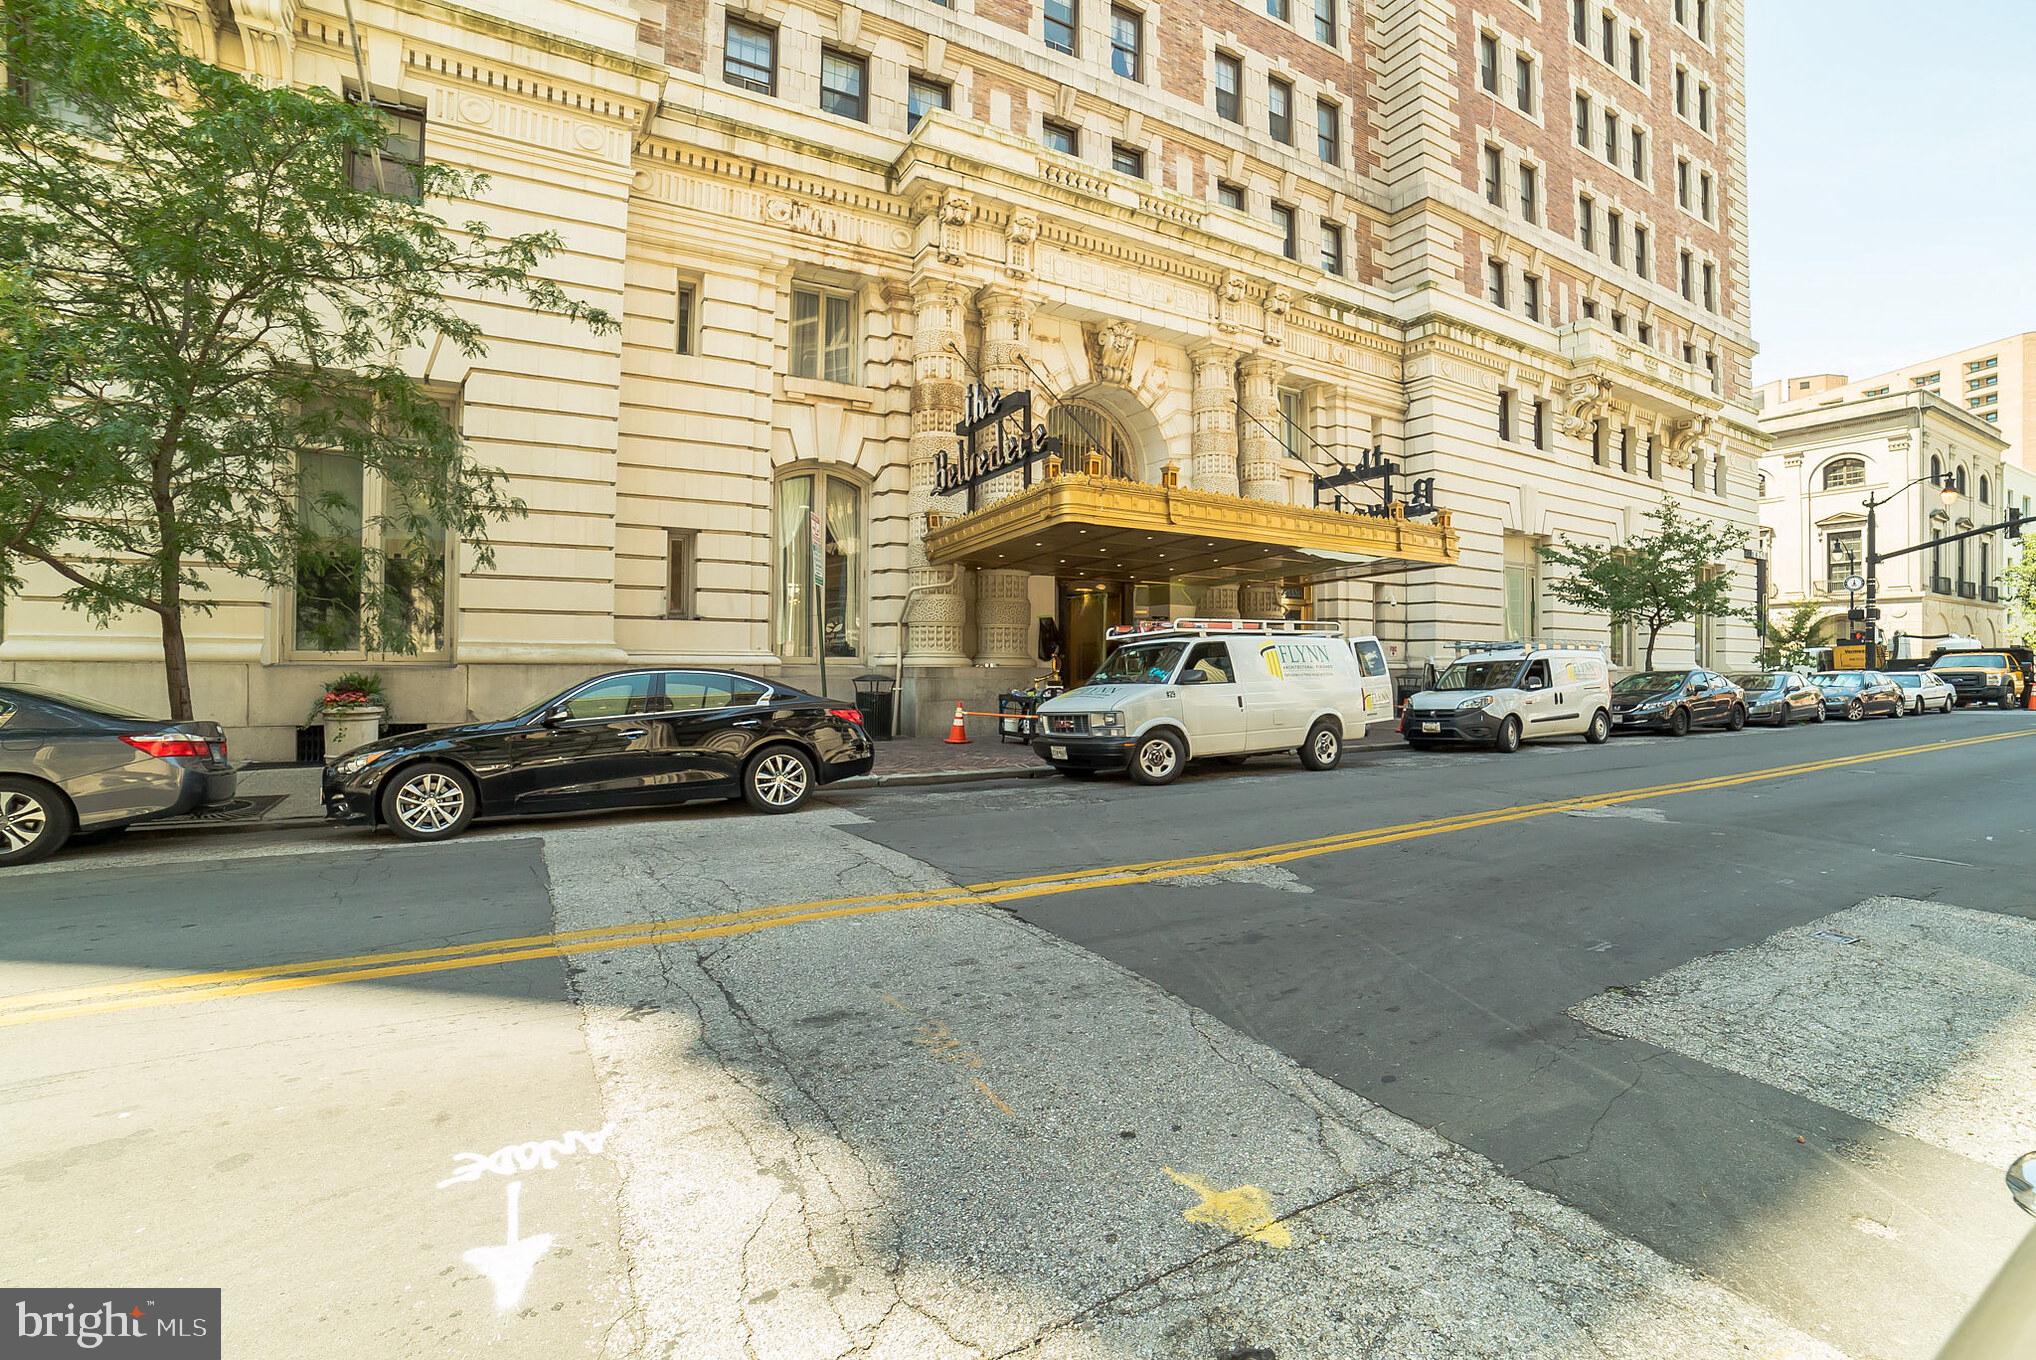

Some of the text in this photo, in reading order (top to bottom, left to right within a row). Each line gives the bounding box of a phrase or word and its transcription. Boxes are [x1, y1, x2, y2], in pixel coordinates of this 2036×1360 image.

[965, 380, 1001, 427] the
[930, 423, 1048, 497] Belvedere
[1278, 644, 1330, 663] FLYNN
